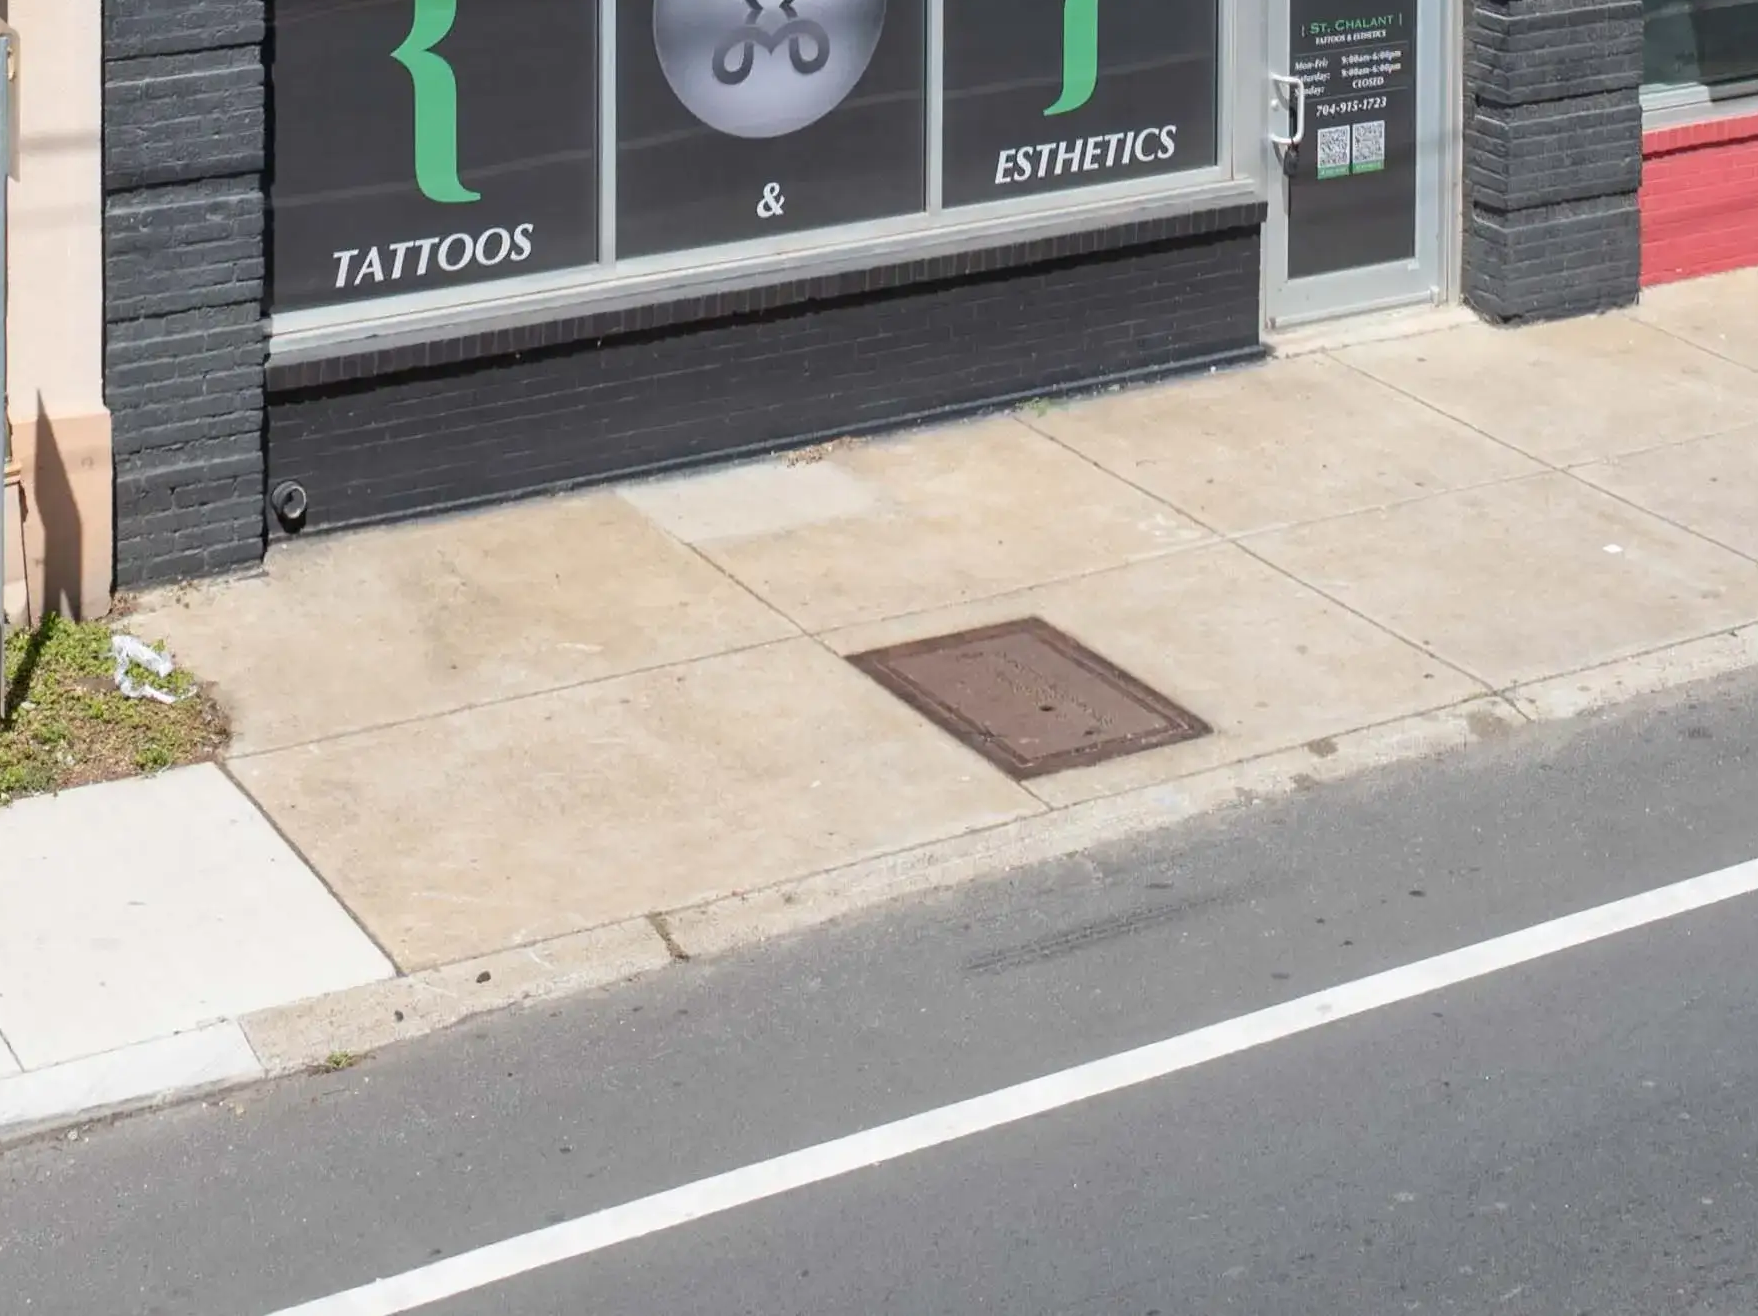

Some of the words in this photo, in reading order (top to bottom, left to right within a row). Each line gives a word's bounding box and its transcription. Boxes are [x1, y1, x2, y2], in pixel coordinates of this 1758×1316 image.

[1309, 22, 1331, 35] ST.
[1334, 14, 1394, 32] CHALANT
[1294, 85, 1325, 98] Snday:
[1352, 76, 1385, 90] CLOSED
[1316, 96, 1387, 118] 704-915-1723
[994, 124, 1177, 184] ESTHETICS
[756, 182, 786, 217] &
[332, 223, 534, 288] TATTOOS
